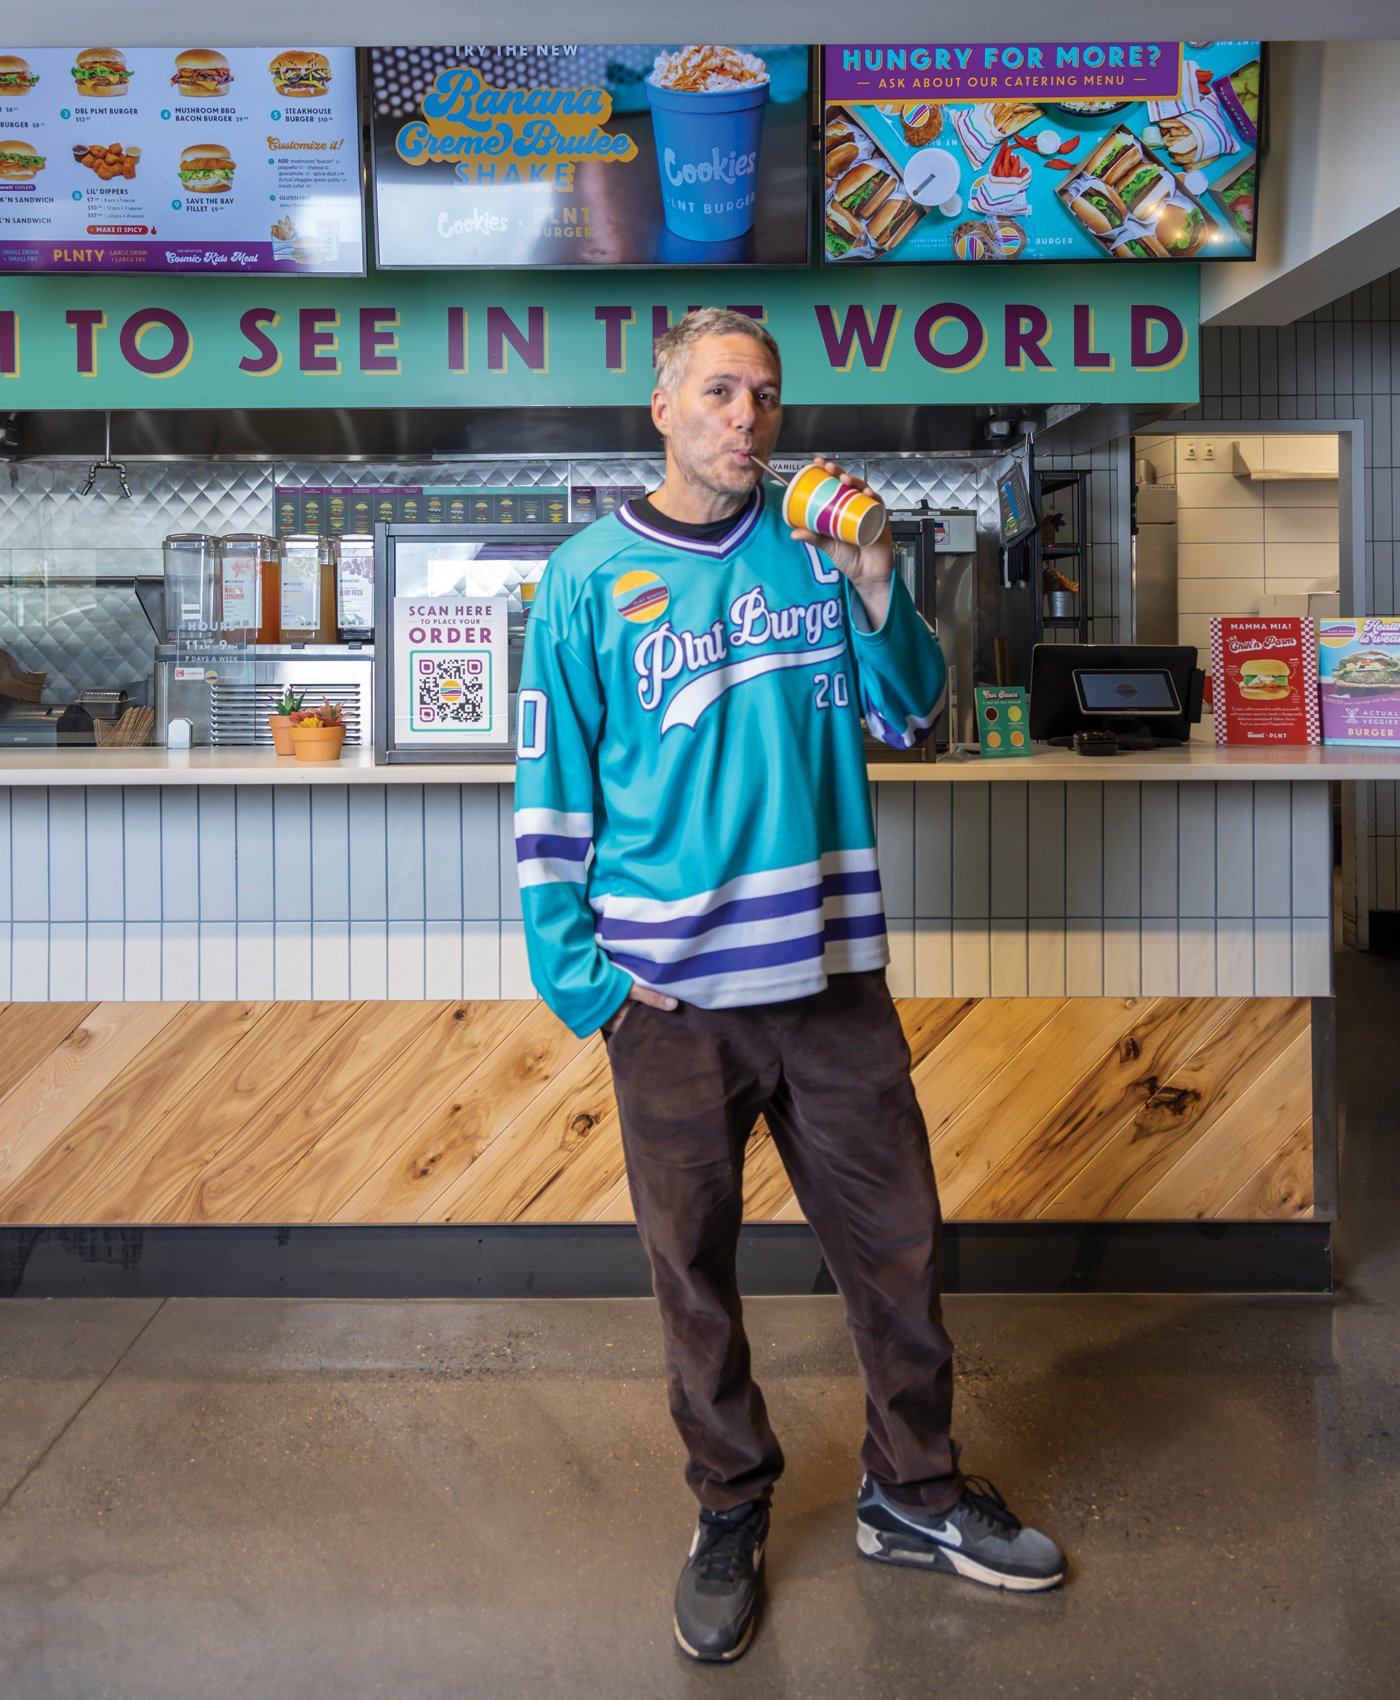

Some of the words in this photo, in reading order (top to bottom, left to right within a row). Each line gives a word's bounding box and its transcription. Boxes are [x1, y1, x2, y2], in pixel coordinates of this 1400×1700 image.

[454, 45, 486, 56] TRY
[495, 45, 528, 56] THE
[536, 45, 578, 56] NEW
[842, 47, 972, 71] HUNGRY
[984, 46, 1044, 70] FOR
[1055, 45, 1162, 69] MORE?
[878, 78, 906, 88] ASK
[912, 77, 961, 88] ABOUT
[967, 76, 998, 87] OUR
[1005, 75, 1077, 87] CATERING
[1084, 75, 1125, 86] MENU
[423, 69, 606, 133] Banana
[267, 135, 327, 151] Customize
[329, 138, 344, 151] it!
[396, 122, 514, 158] Creme
[512, 120, 631, 157] Brulee
[664, 146, 756, 187] Cookies
[455, 163, 571, 190] SHAKE
[703, 191, 756, 215] BURGER
[436, 208, 509, 239] Cookies
[533, 226, 593, 239] BURGER
[53, 249, 105, 262] PLNTY
[165, 250, 202, 263] Cosmic
[203, 251, 228, 265] Kids
[230, 251, 259, 265] Meal
[65, 307, 194, 378] TO
[239, 307, 402, 377] SEE
[448, 306, 549, 375] IN
[814, 302, 1189, 374] WORLD
[408, 605, 449, 616] SCAN
[455, 605, 492, 616] HERE
[408, 627, 492, 644] ORDER
[1225, 635, 1237, 643] THE
[1263, 635, 1297, 650] Parm
[633, 617, 727, 711] Plnt
[813, 672, 849, 709] 20
[1348, 728, 1394, 737] BURGER
